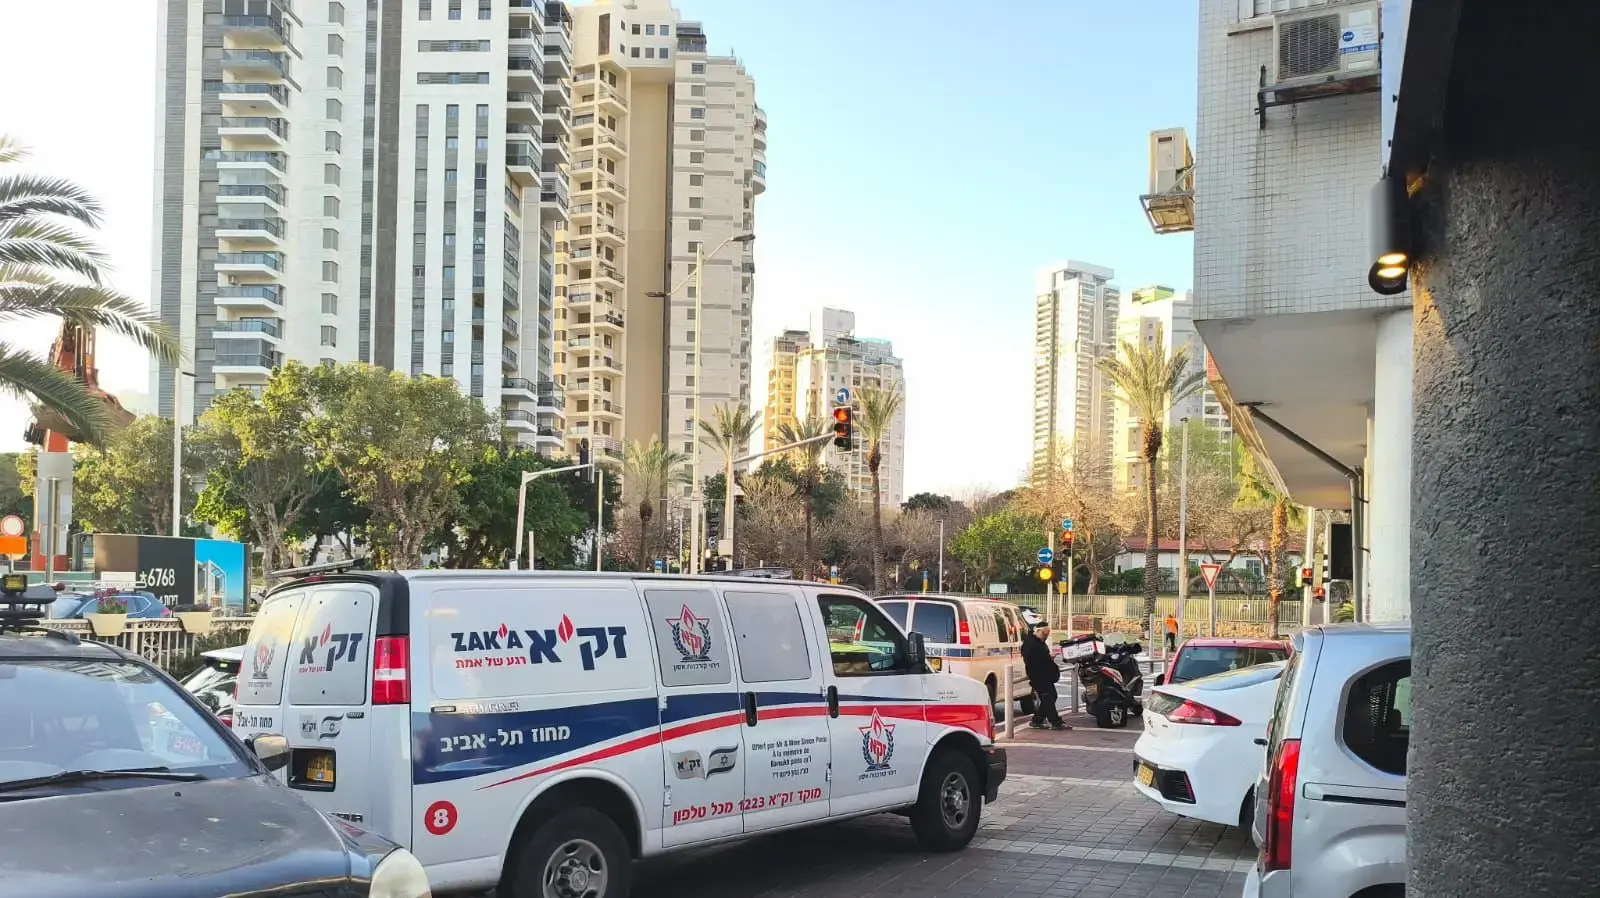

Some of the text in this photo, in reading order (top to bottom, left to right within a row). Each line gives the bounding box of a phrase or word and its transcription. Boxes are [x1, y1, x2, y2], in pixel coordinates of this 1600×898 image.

[455, 656, 527, 669] רגע של אמת
[440, 725, 571, 753] מחוז תל-אביב
[799, 787, 822, 801] מוקד
[711, 802, 733, 816] מכל
[738, 796, 765, 811] 1223
[433, 808, 449, 828] 8
[673, 805, 706, 825] טלפון
